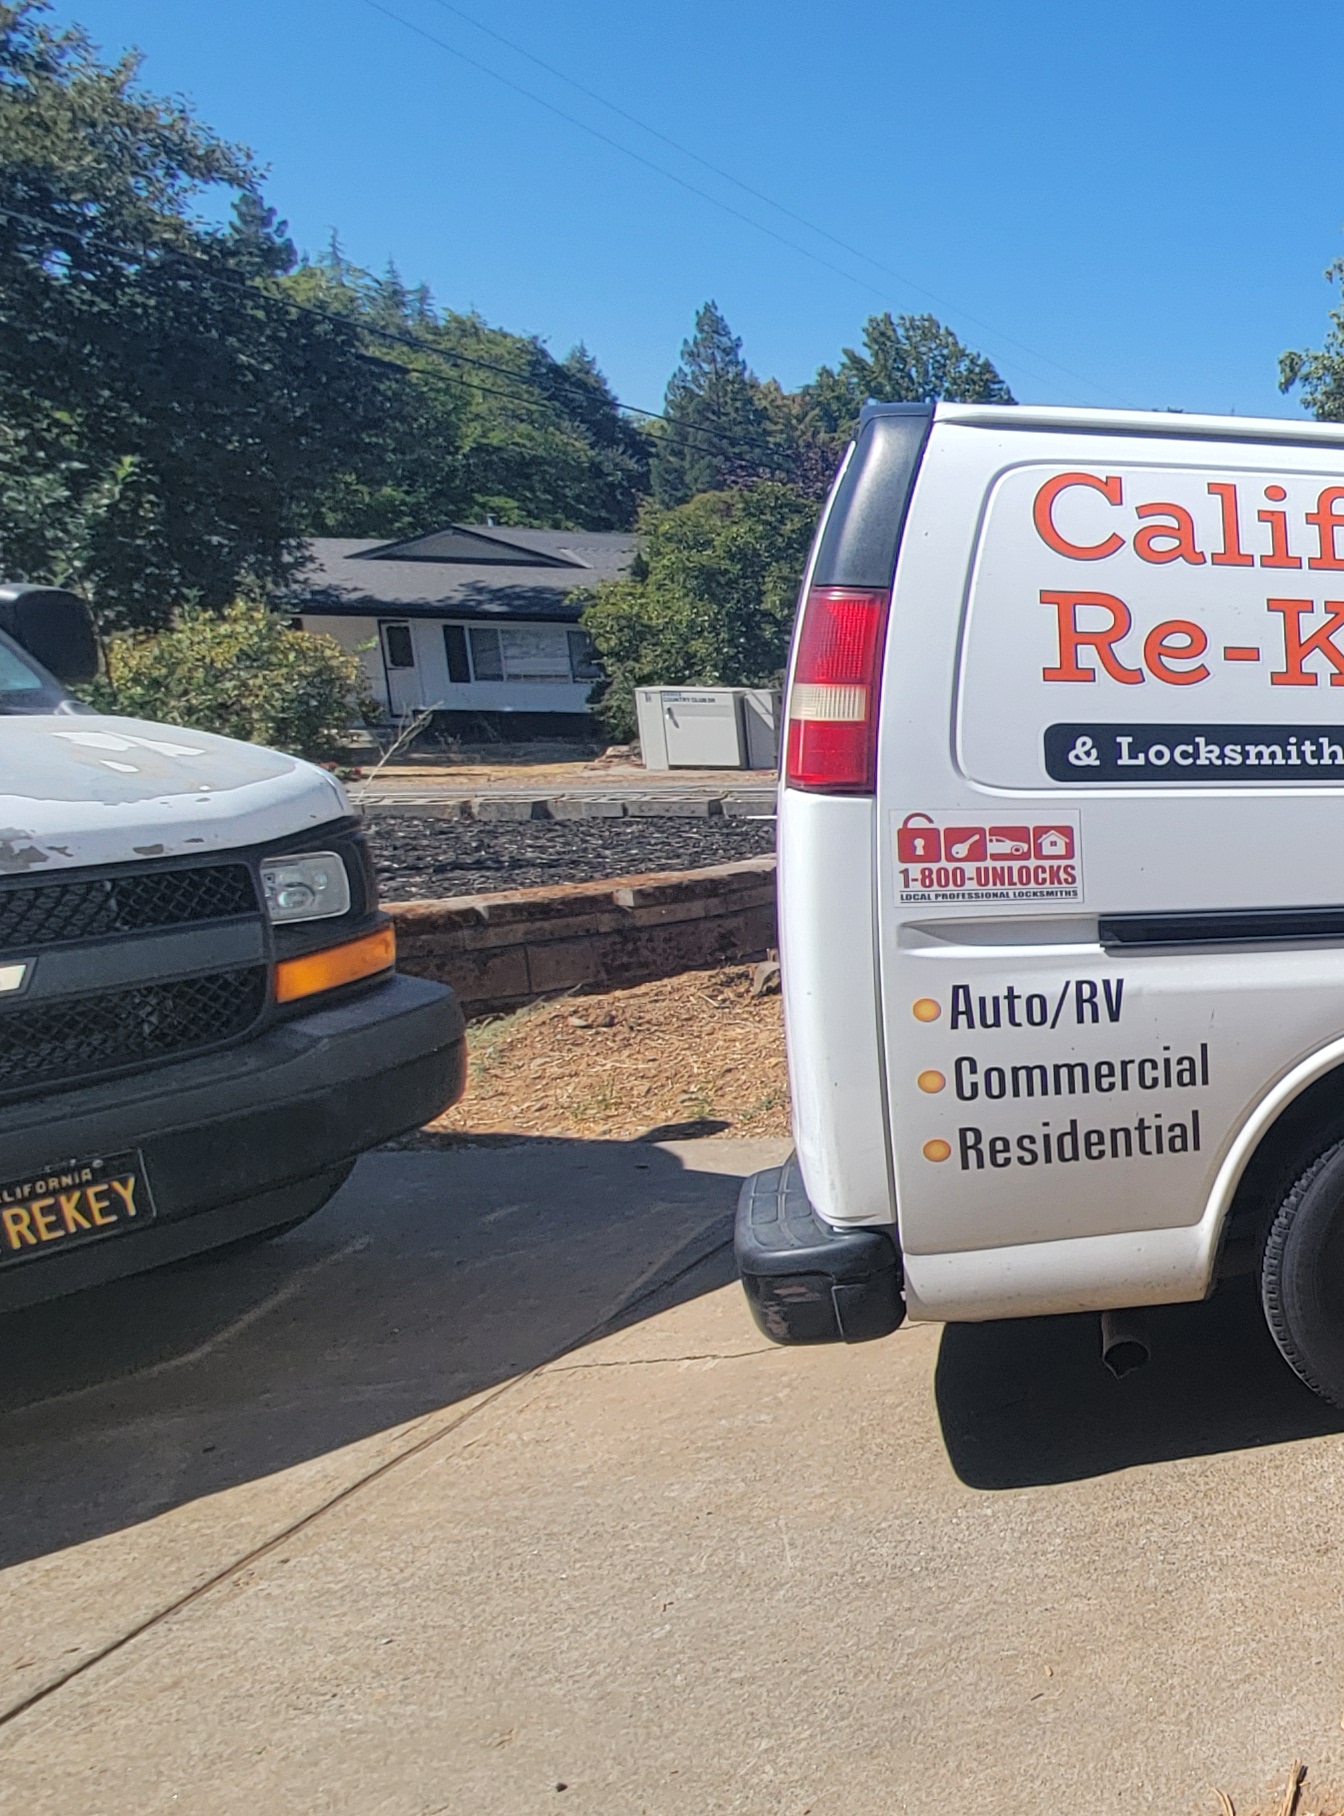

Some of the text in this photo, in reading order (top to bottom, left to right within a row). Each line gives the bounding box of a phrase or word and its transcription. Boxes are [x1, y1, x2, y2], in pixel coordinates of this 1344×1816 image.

[1067, 738, 1101, 767] &
[899, 865, 1077, 889] 1-800-UNLOCKS
[900, 890, 1078, 901] LOCAL PROFESSIONAL LOCKSMITHS
[950, 978, 1124, 1030] Auto/RV
[954, 1042, 1209, 1101] Commercial
[958, 1110, 1200, 1170] Residential
[0, 1168, 93, 1203] LIFORNIA
[0, 1176, 137, 1250] REKEY
